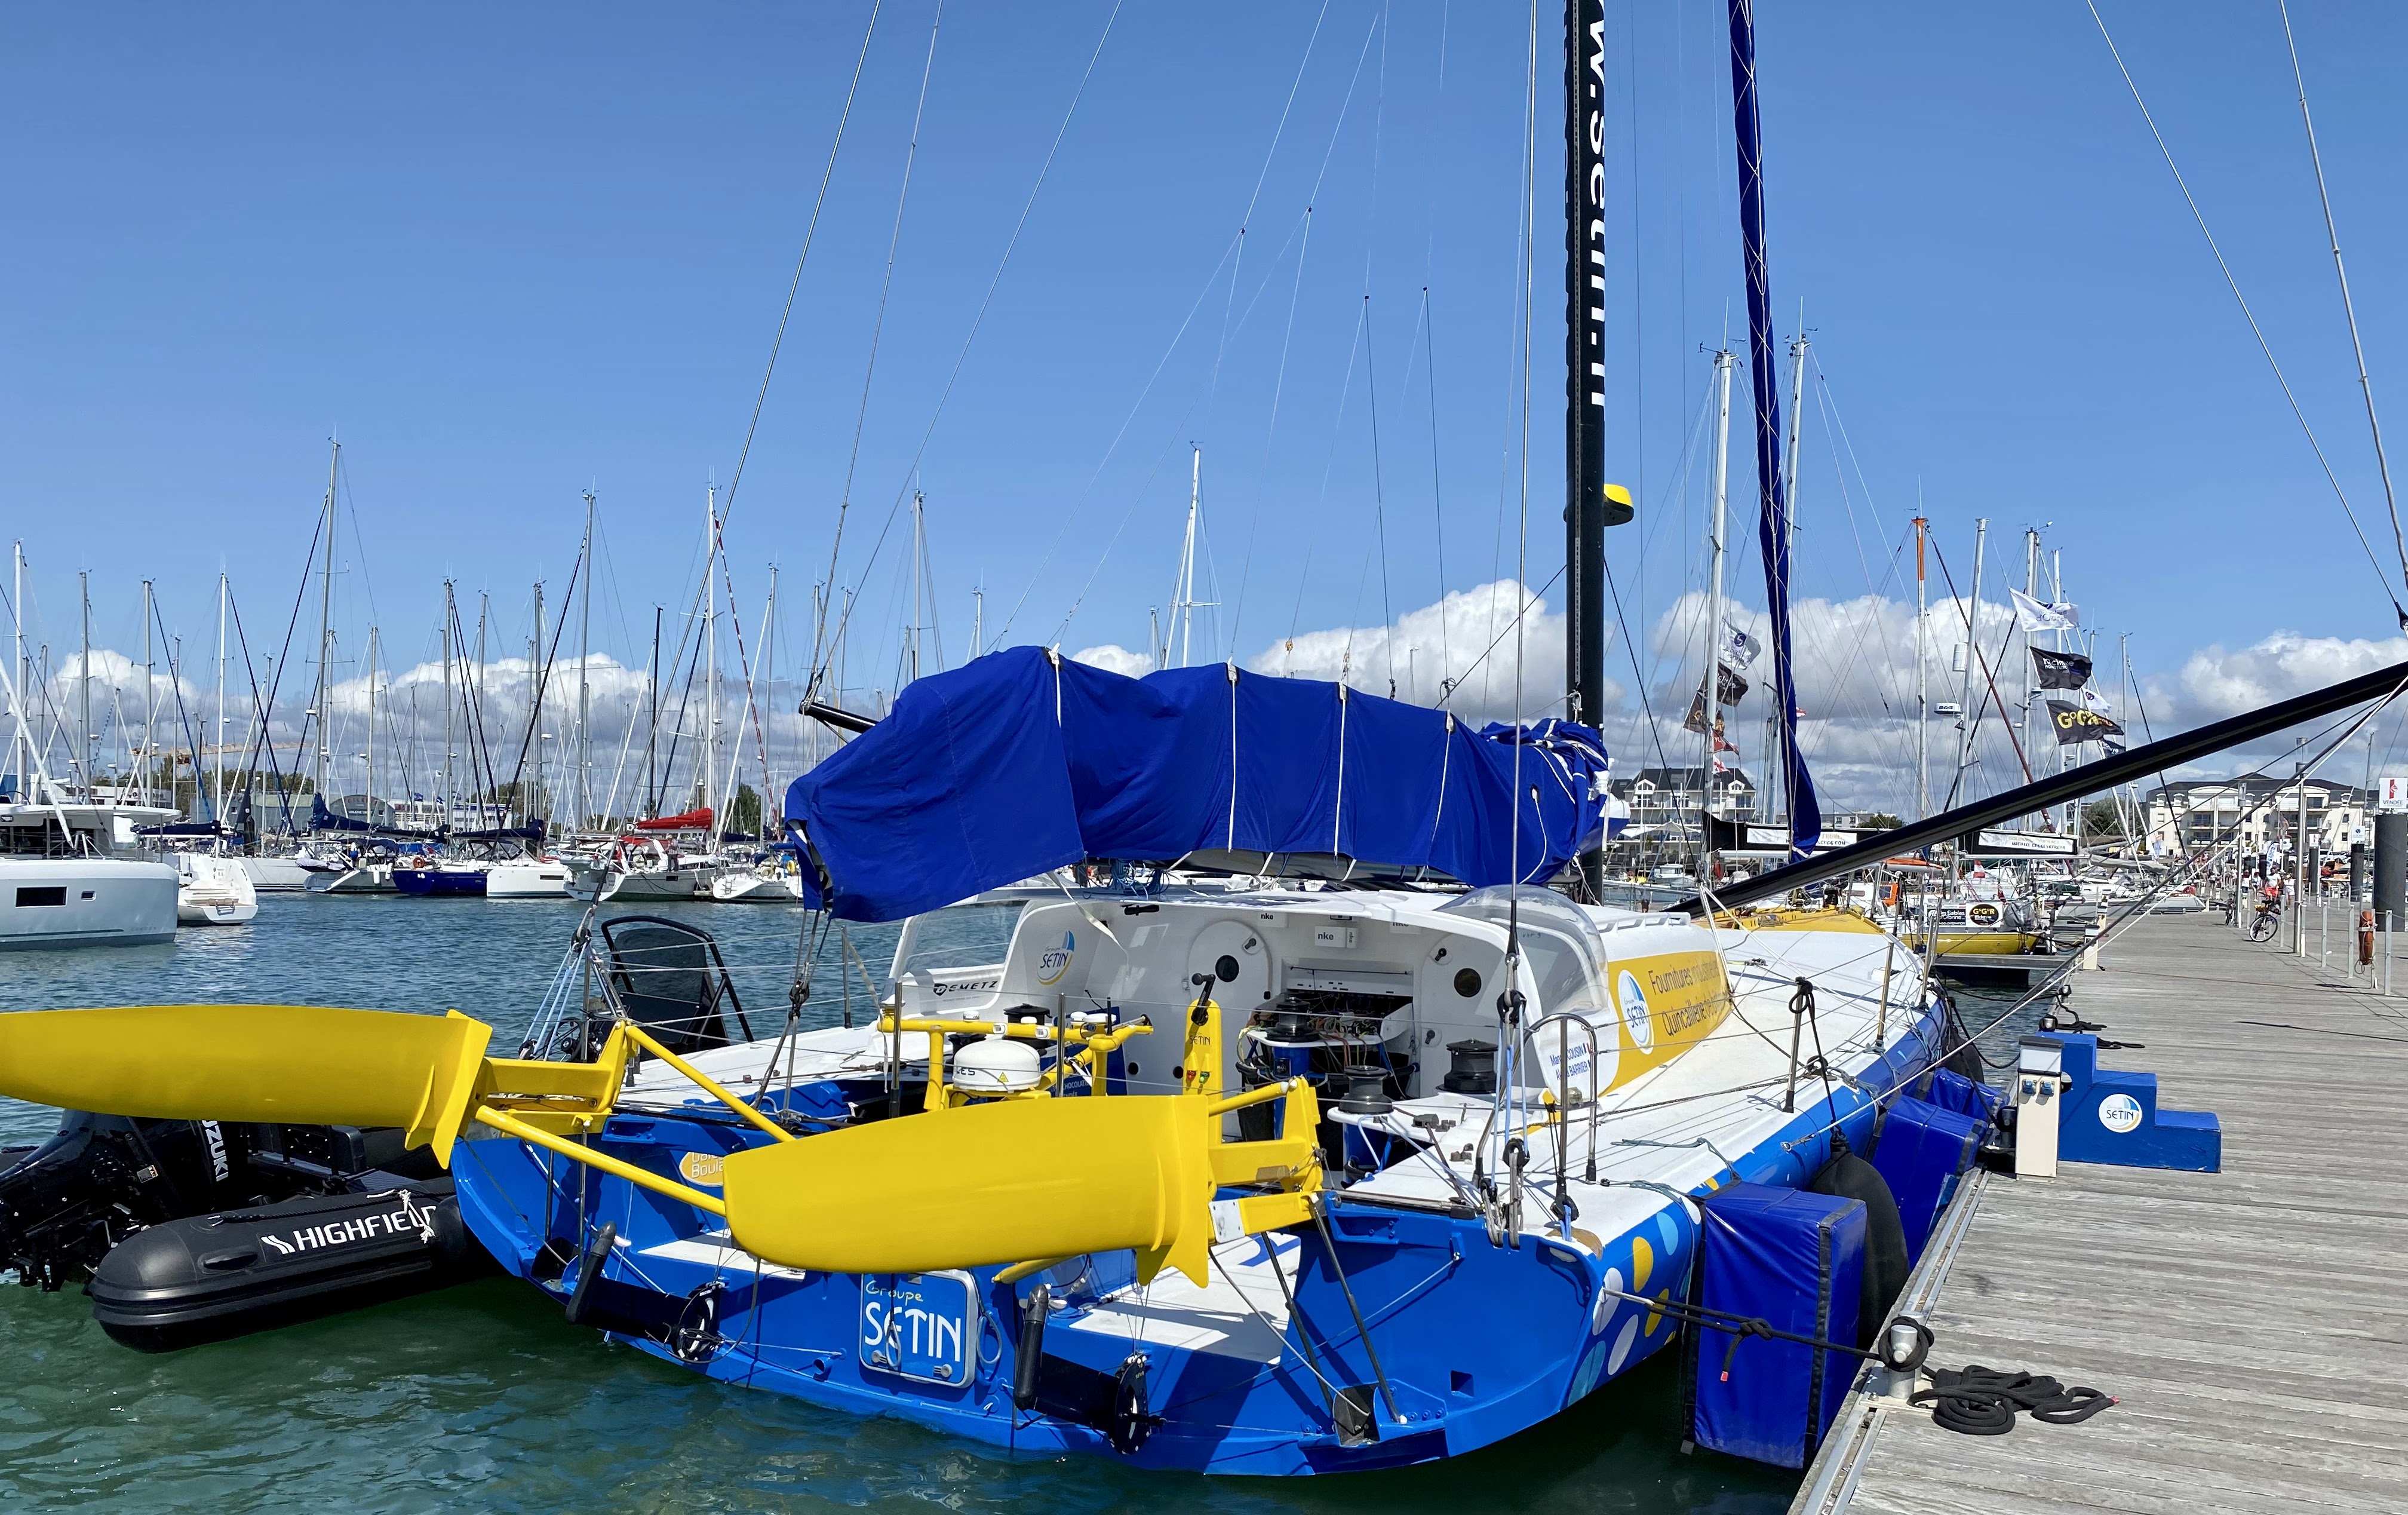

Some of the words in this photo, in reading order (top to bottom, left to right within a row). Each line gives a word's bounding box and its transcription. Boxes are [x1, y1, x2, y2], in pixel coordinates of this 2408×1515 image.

[1317, 931, 1334, 940] nke
[1040, 952, 1069, 969] SETIN
[1648, 964, 1694, 995] Fournitures
[1189, 1035, 1211, 1045] SETIN
[2106, 1109, 2134, 1120] SETIN
[202, 1120, 229, 1182] ZUKI
[692, 1158, 724, 1178] Boula
[865, 1280, 924, 1307] Groupe
[865, 1301, 962, 1362] SETIN
